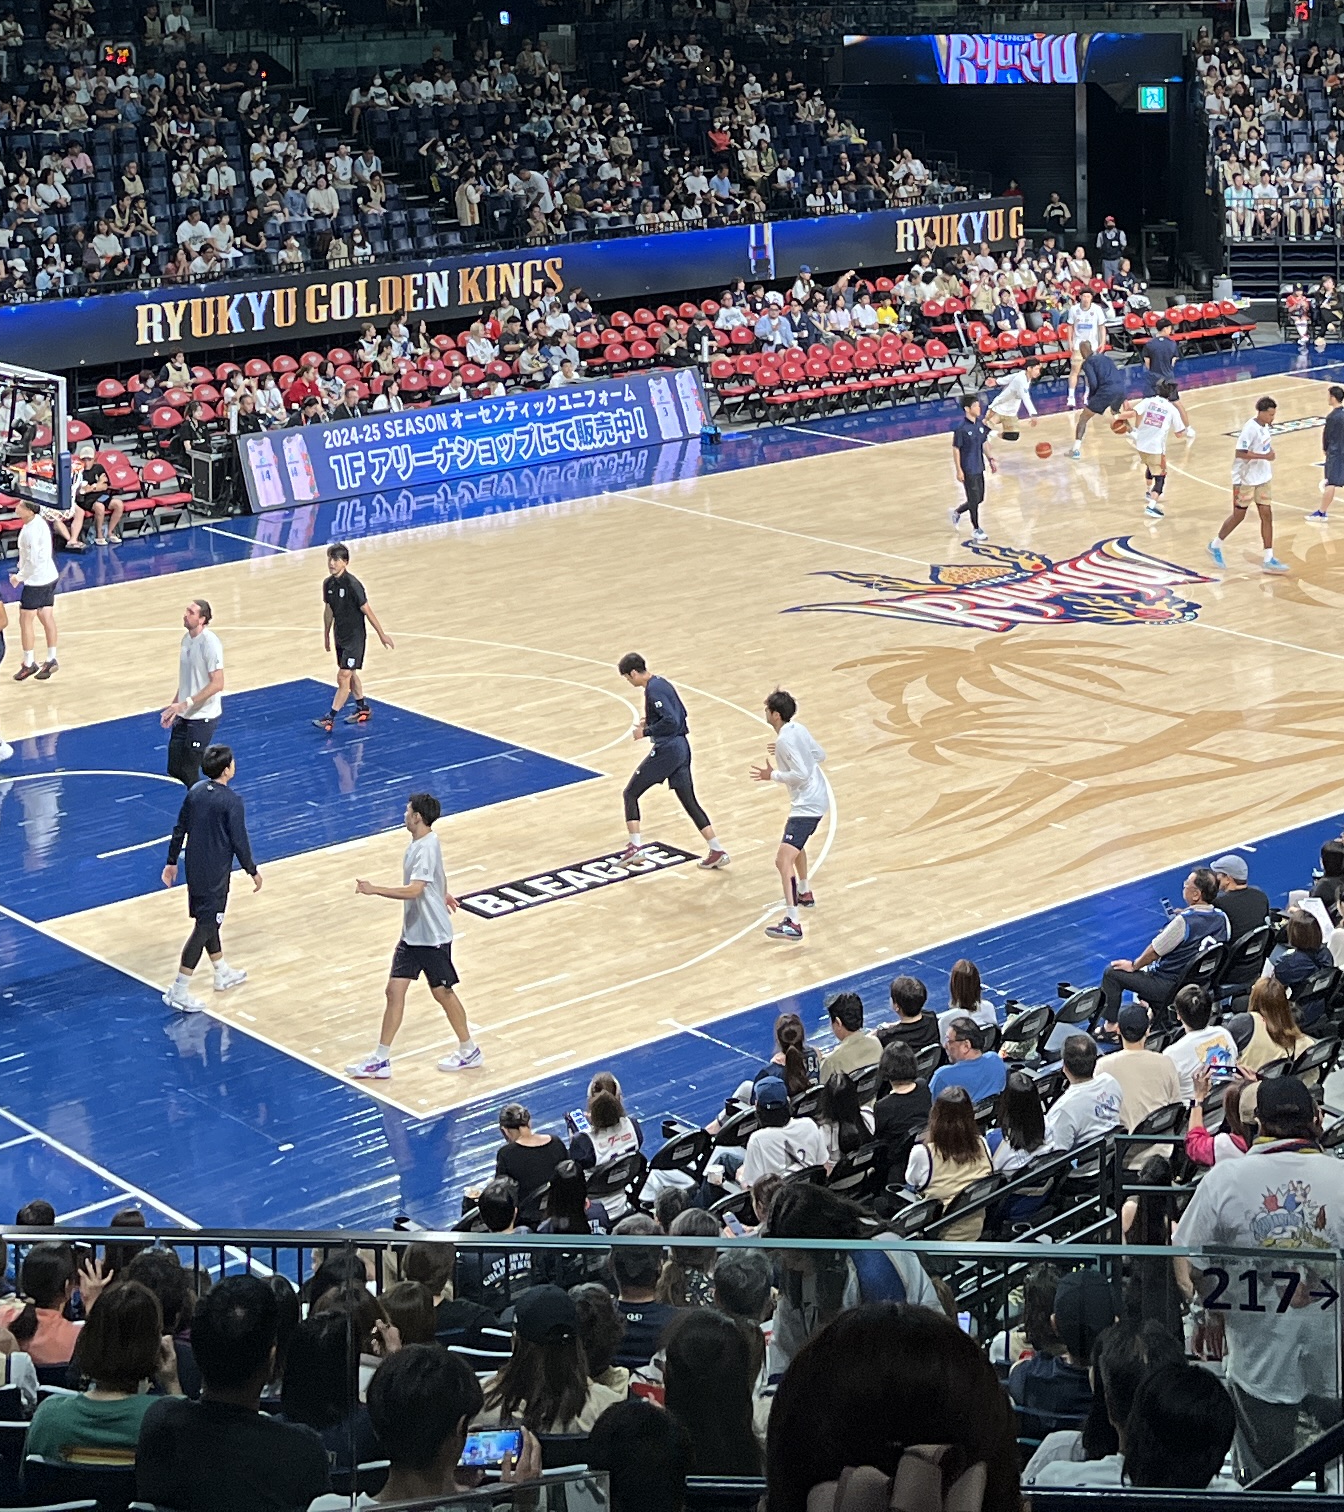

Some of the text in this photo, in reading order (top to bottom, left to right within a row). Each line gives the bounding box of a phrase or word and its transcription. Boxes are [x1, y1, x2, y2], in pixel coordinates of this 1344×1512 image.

[896, 209, 1005, 253] RYUKYU
[134, 257, 565, 346] RYUKYU GOLDEN KINGS
[323, 384, 636, 448] 2024-25 SEASON オーセンティックユニフォーム
[1202, 1266, 1301, 1314] 217
